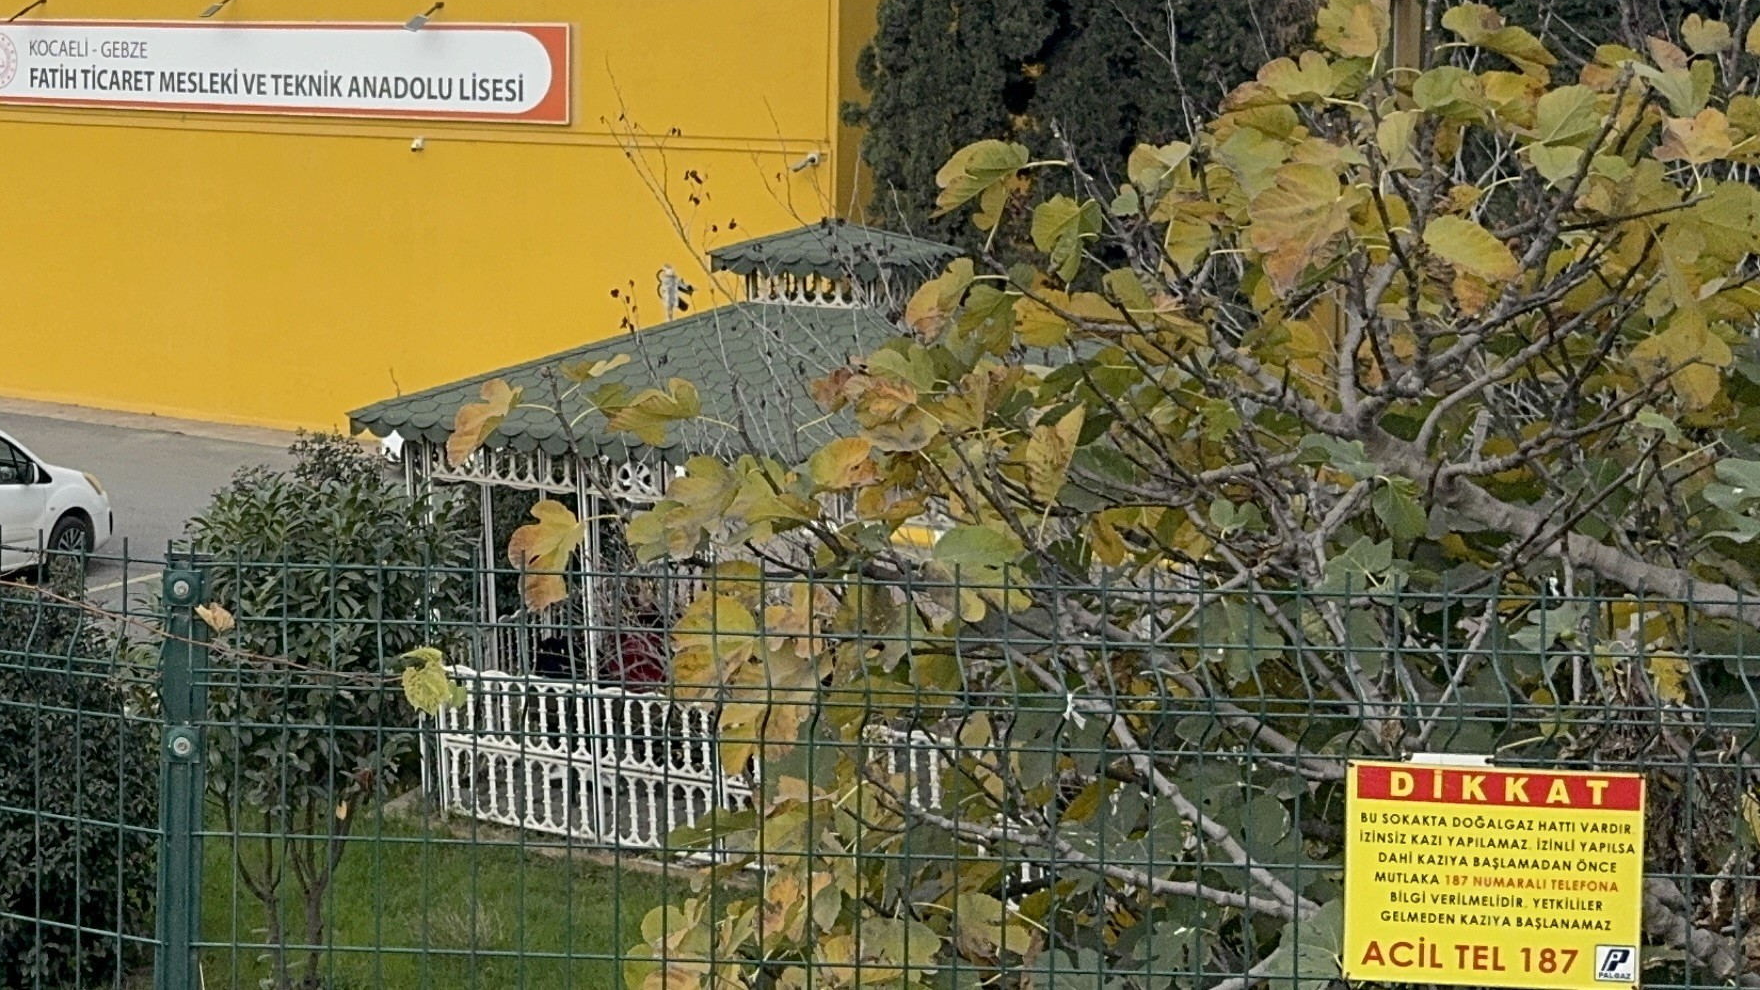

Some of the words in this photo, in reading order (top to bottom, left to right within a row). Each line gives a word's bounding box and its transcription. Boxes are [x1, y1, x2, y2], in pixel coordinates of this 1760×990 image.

[29, 37, 88, 57] KOCAELİ
[101, 41, 148, 59] GEBZE
[30, 63, 77, 89] FATİH
[81, 64, 155, 92] TİCARET
[159, 68, 238, 95] MESLEKİ
[242, 73, 267, 96] VE
[271, 70, 343, 97] TEKNİK
[347, 75, 453, 100] ANADOLU
[459, 72, 524, 102] LİSESİ
[1390, 769, 1609, 805] DİKKAT
[1360, 812, 1377, 824] BU
[1382, 813, 1447, 827] SOKAKTA
[1452, 815, 1534, 831] DOĞALGAZ
[1538, 820, 1575, 832] HATTI
[1360, 829, 1406, 844] İZİNSİZ
[1411, 834, 1442, 846] KAZI
[1536, 837, 1575, 851] İZİNLİ
[1580, 841, 1635, 854] YAPILSA
[1378, 851, 1413, 864] DAHİ
[1418, 854, 1468, 867] KAZIYA
[1473, 856, 1571, 871] BAŞLAMADAN
[1576, 859, 1617, 873] ÖNCE
[1374, 871, 1440, 885] MUTLAKA
[1445, 875, 1468, 886] 187
[1473, 876, 1546, 889] NUMARALI
[1551, 879, 1619, 892] TELEFONA
[1390, 890, 1425, 903] BİLGİ
[1533, 897, 1603, 911] YETKİLİLER
[1380, 910, 1455, 924] GELMEDEN
[1460, 914, 1511, 927] KAZIYA
[1516, 916, 1611, 931] BAŞLANAMAZ
[1361, 936, 1443, 969] ACİL
[1455, 944, 1505, 971] TEL
[1520, 947, 1579, 974] 187
[1598, 971, 1631, 980] PALGAZ
